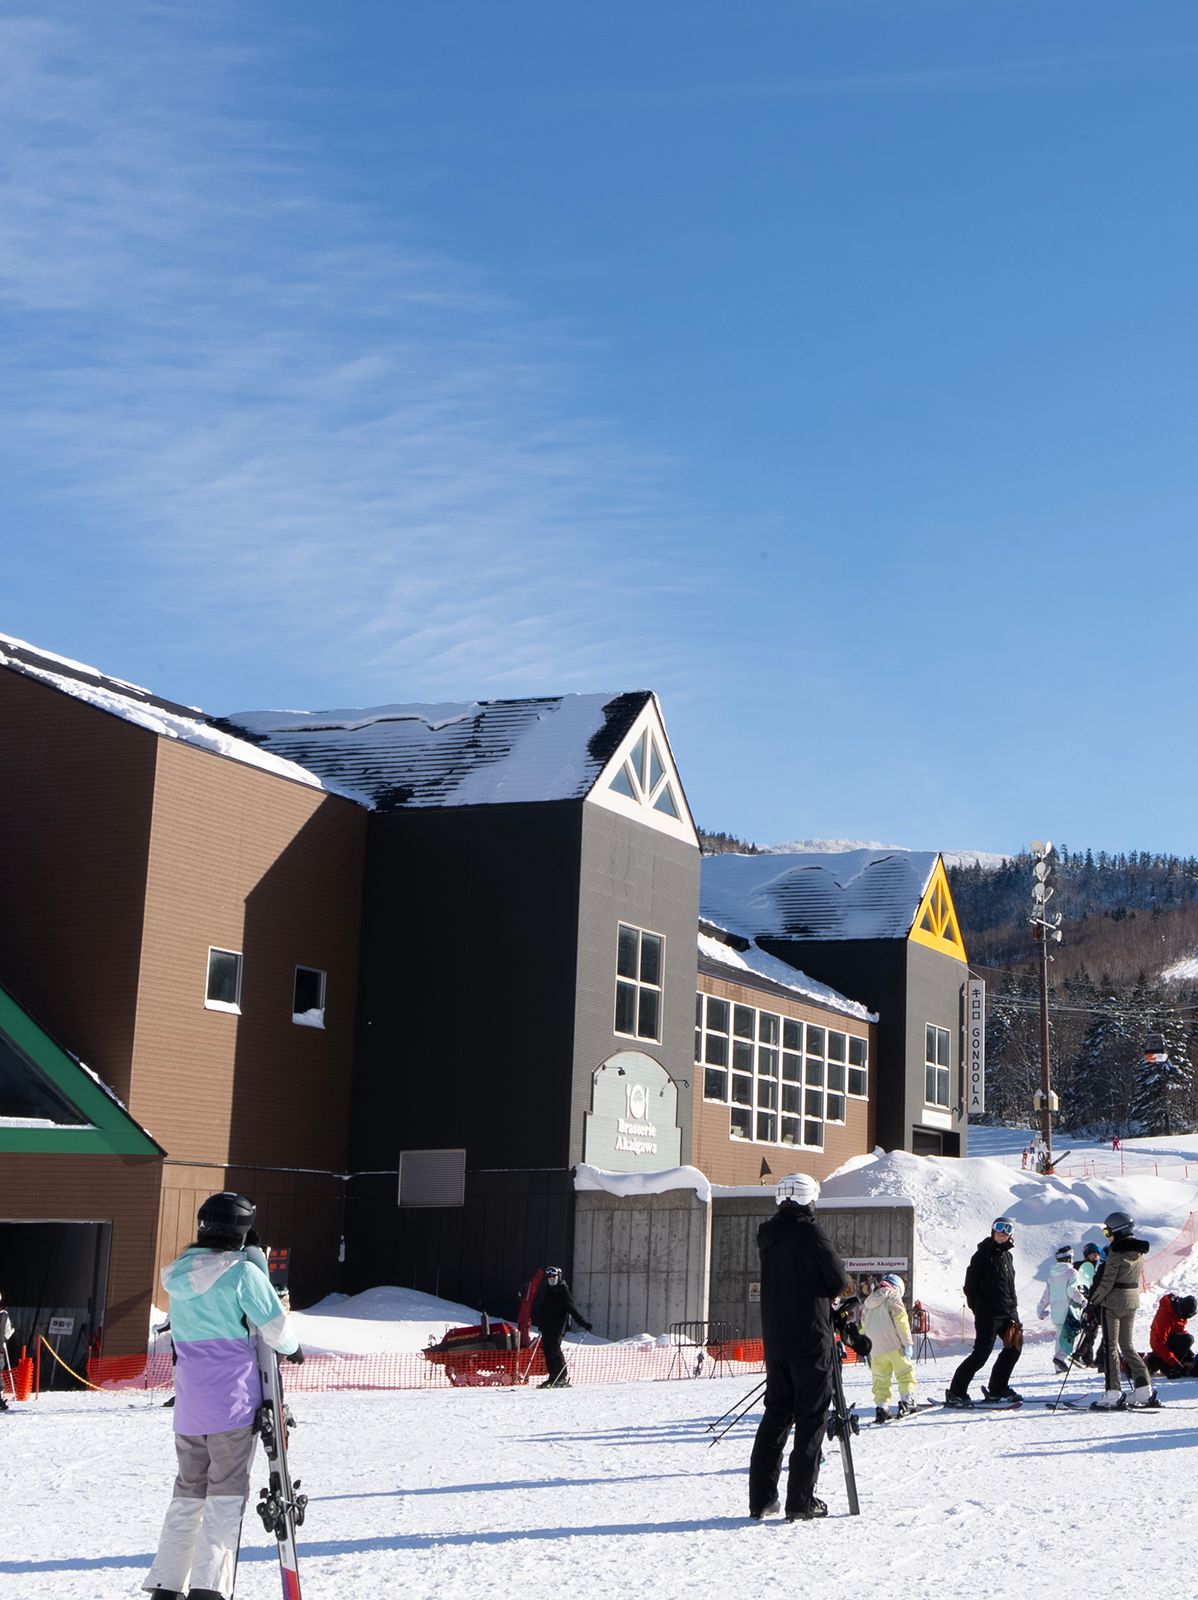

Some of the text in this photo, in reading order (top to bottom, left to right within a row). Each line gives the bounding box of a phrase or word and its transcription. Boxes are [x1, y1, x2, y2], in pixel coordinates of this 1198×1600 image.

[971, 988, 981, 1020] キロロ
[971, 1027, 980, 1106] GONDOLA
[616, 1119, 657, 1138] Brasserie
[614, 1135, 657, 1156] Akaigawa
